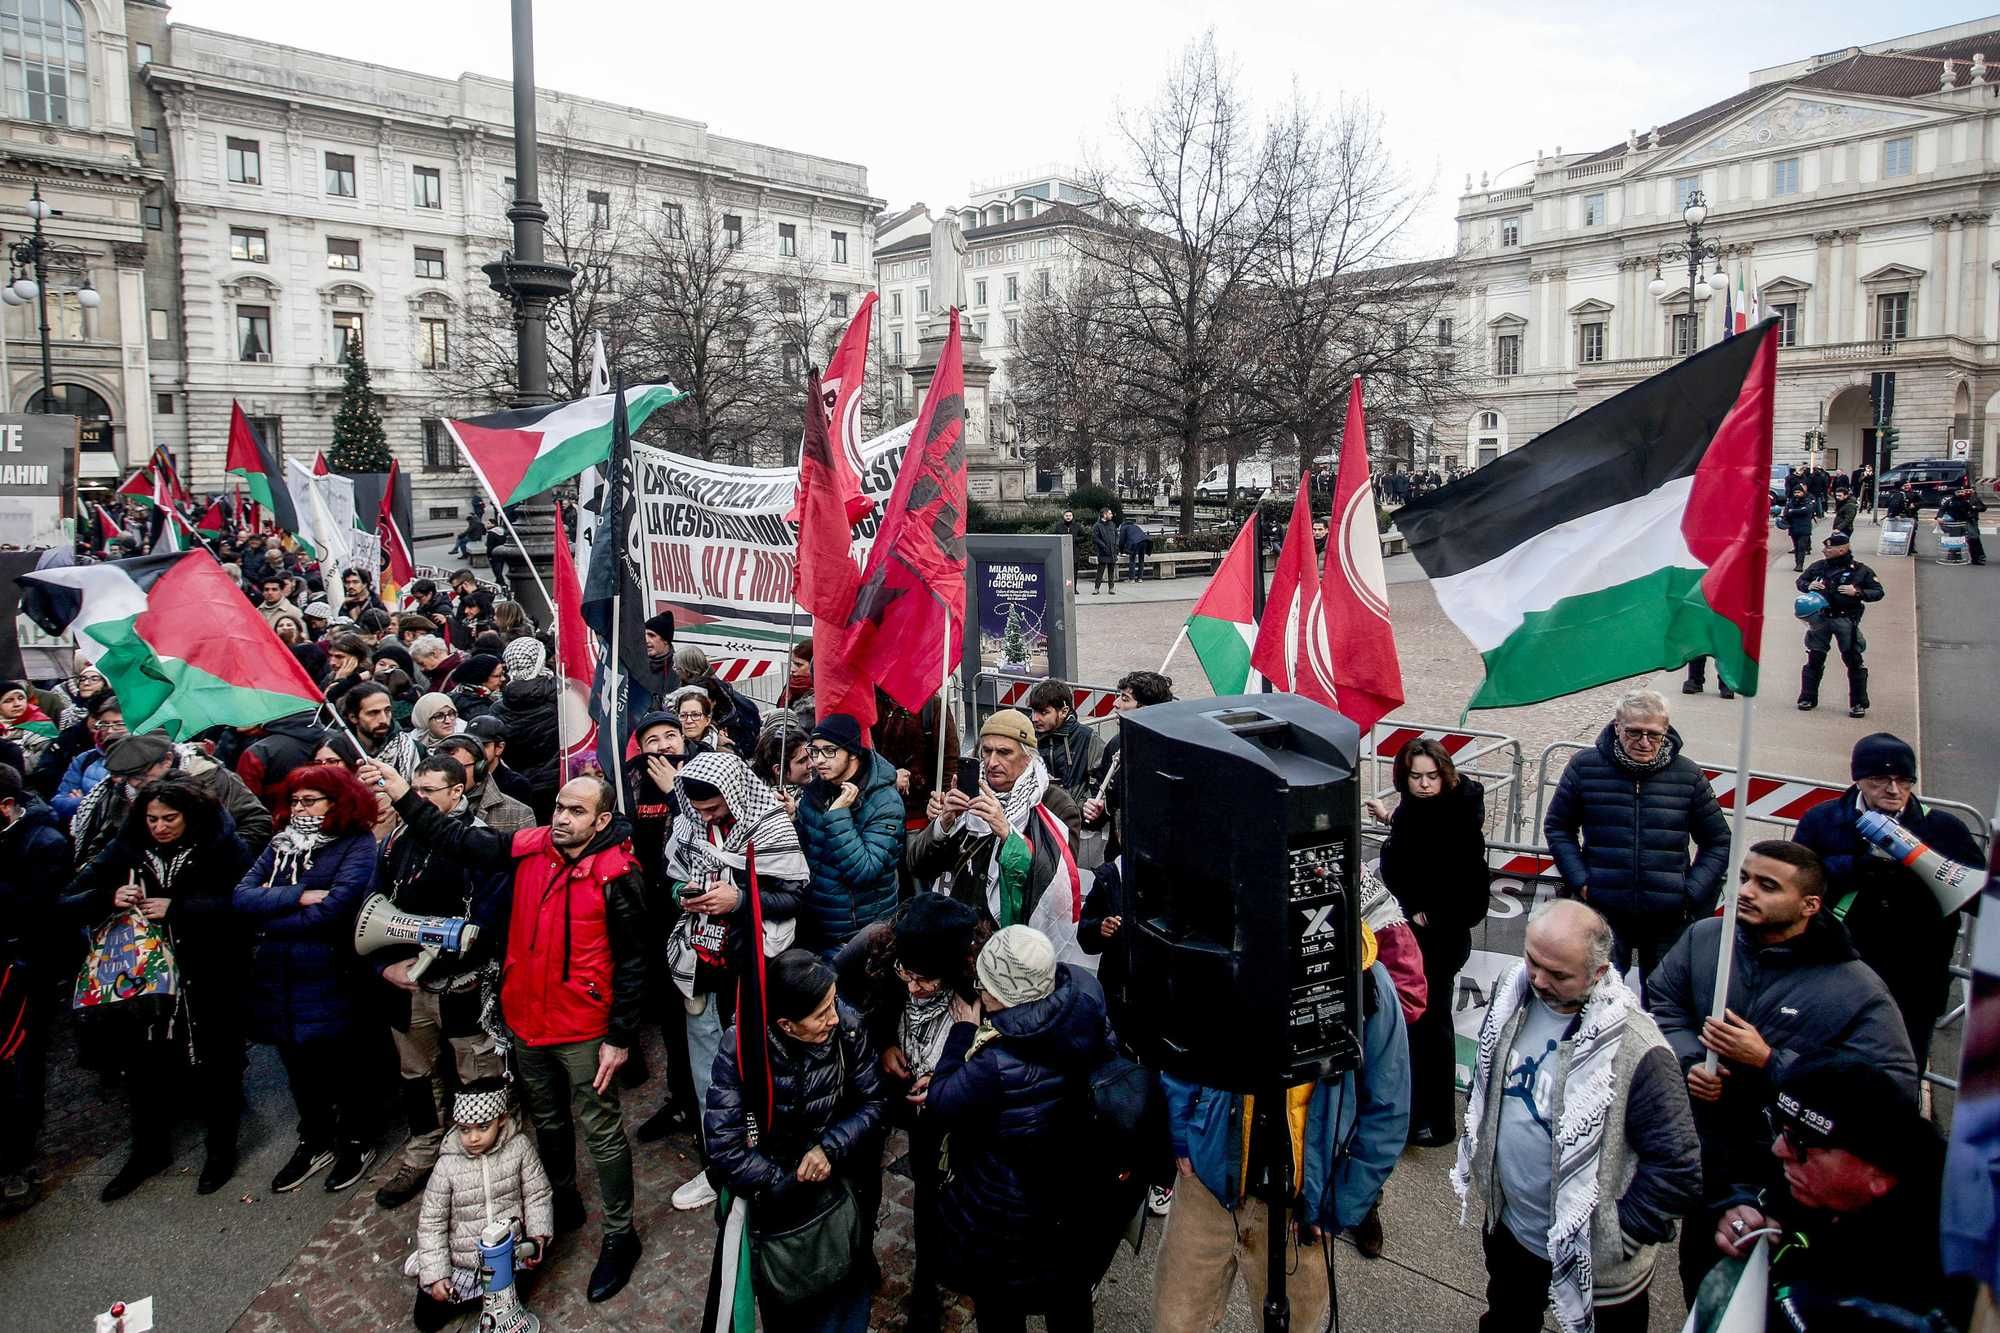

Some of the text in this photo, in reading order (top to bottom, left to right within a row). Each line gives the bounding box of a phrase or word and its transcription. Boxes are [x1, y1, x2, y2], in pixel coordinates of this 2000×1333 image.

[0, 465, 48, 485] AHIN
[664, 503, 757, 543] RESISTENZA
[734, 548, 749, 600] E
[989, 565, 1022, 575] MILANO,
[996, 573, 1038, 582] ARRIVANO
[993, 580, 1024, 589] GIOCHI!
[386, 926, 418, 940] PALESTINE
[1301, 932, 1335, 943] LITE
[1306, 962, 1331, 975] FBT
[1778, 1092, 1800, 1112] USC
[1803, 1109, 1833, 1130] 1999
